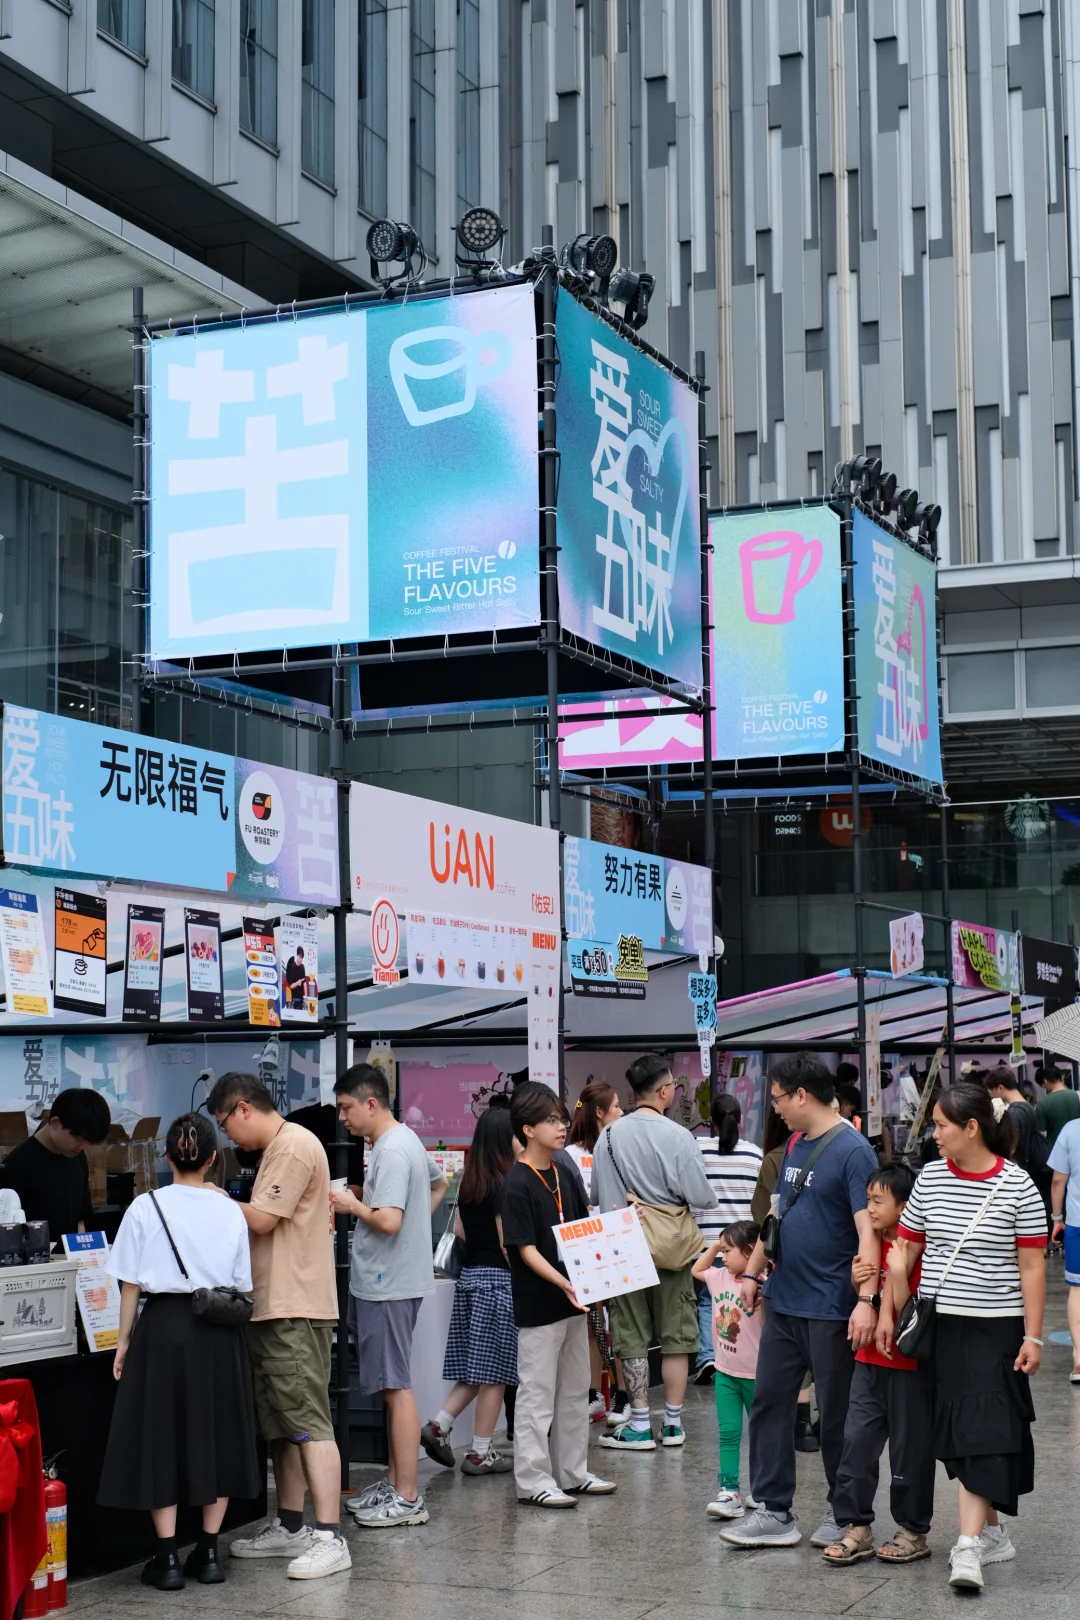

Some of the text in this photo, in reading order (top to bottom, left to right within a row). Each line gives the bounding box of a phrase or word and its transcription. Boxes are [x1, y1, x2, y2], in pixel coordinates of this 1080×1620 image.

[638, 389, 661, 419] SOUR
[639, 474, 664, 503] SALTY
[402, 545, 480, 561] COFFEE FESTIVAL
[403, 555, 497, 582] THE FIVE
[403, 575, 517, 604] FLAVOURS
[403, 607, 423, 616] Sour
[425, 604, 451, 614] Sweet
[453, 601, 476, 611] Bitter
[478, 599, 494, 608] Hot
[742, 700, 813, 719] THE FIVE
[743, 715, 829, 735] FLAVOURS
[100, 740, 229, 821] 无限福气
[244, 824, 252, 833] FU
[774, 814, 802, 823] FOODS
[604, 852, 662, 902] 努力有果
[532, 931, 557, 951] MENU
[373, 967, 399, 986] Tianjin
[690, 977, 716, 999] 想买多少
[697, 1000, 716, 1028] 买多少
[559, 1217, 604, 1242] MENU
